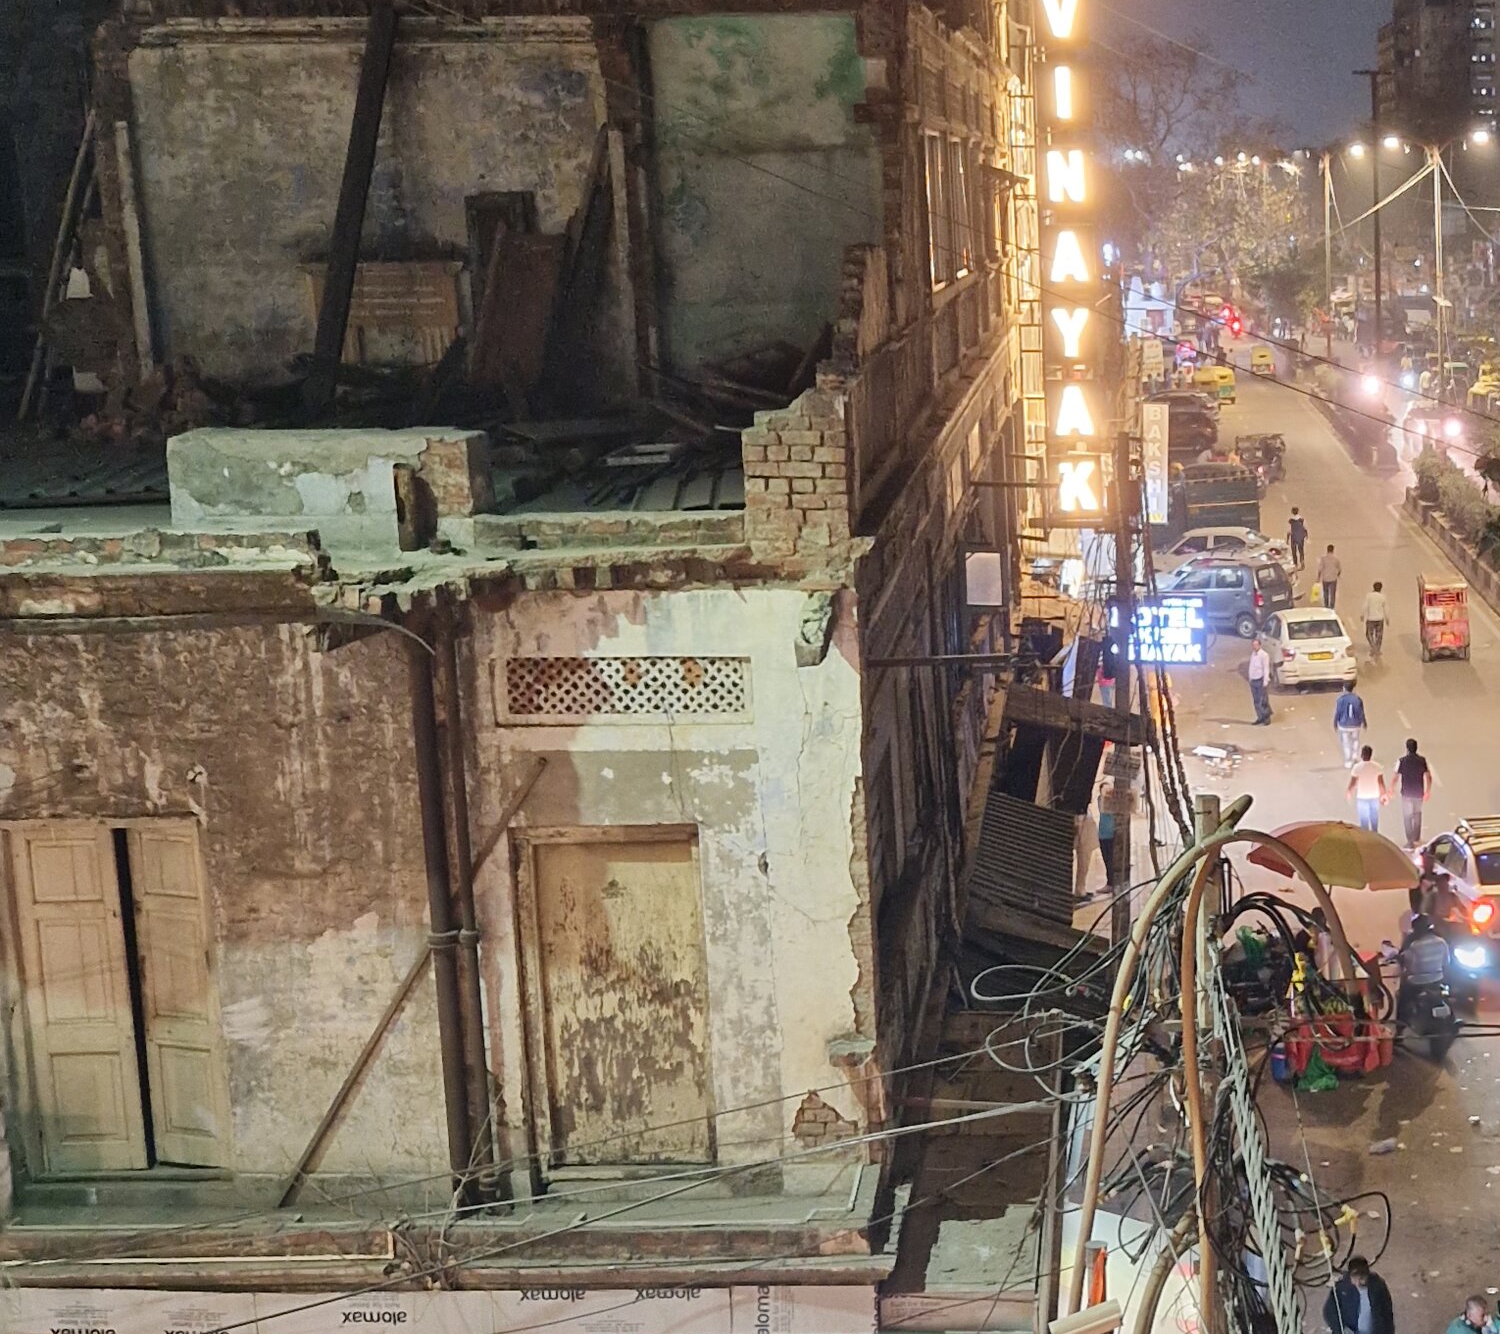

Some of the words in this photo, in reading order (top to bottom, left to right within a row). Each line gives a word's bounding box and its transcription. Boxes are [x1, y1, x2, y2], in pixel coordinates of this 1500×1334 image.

[1146, 407, 1163, 511] BAKSHI
[520, 1289, 586, 1302] alomax
[342, 1310, 408, 1325] alomax
